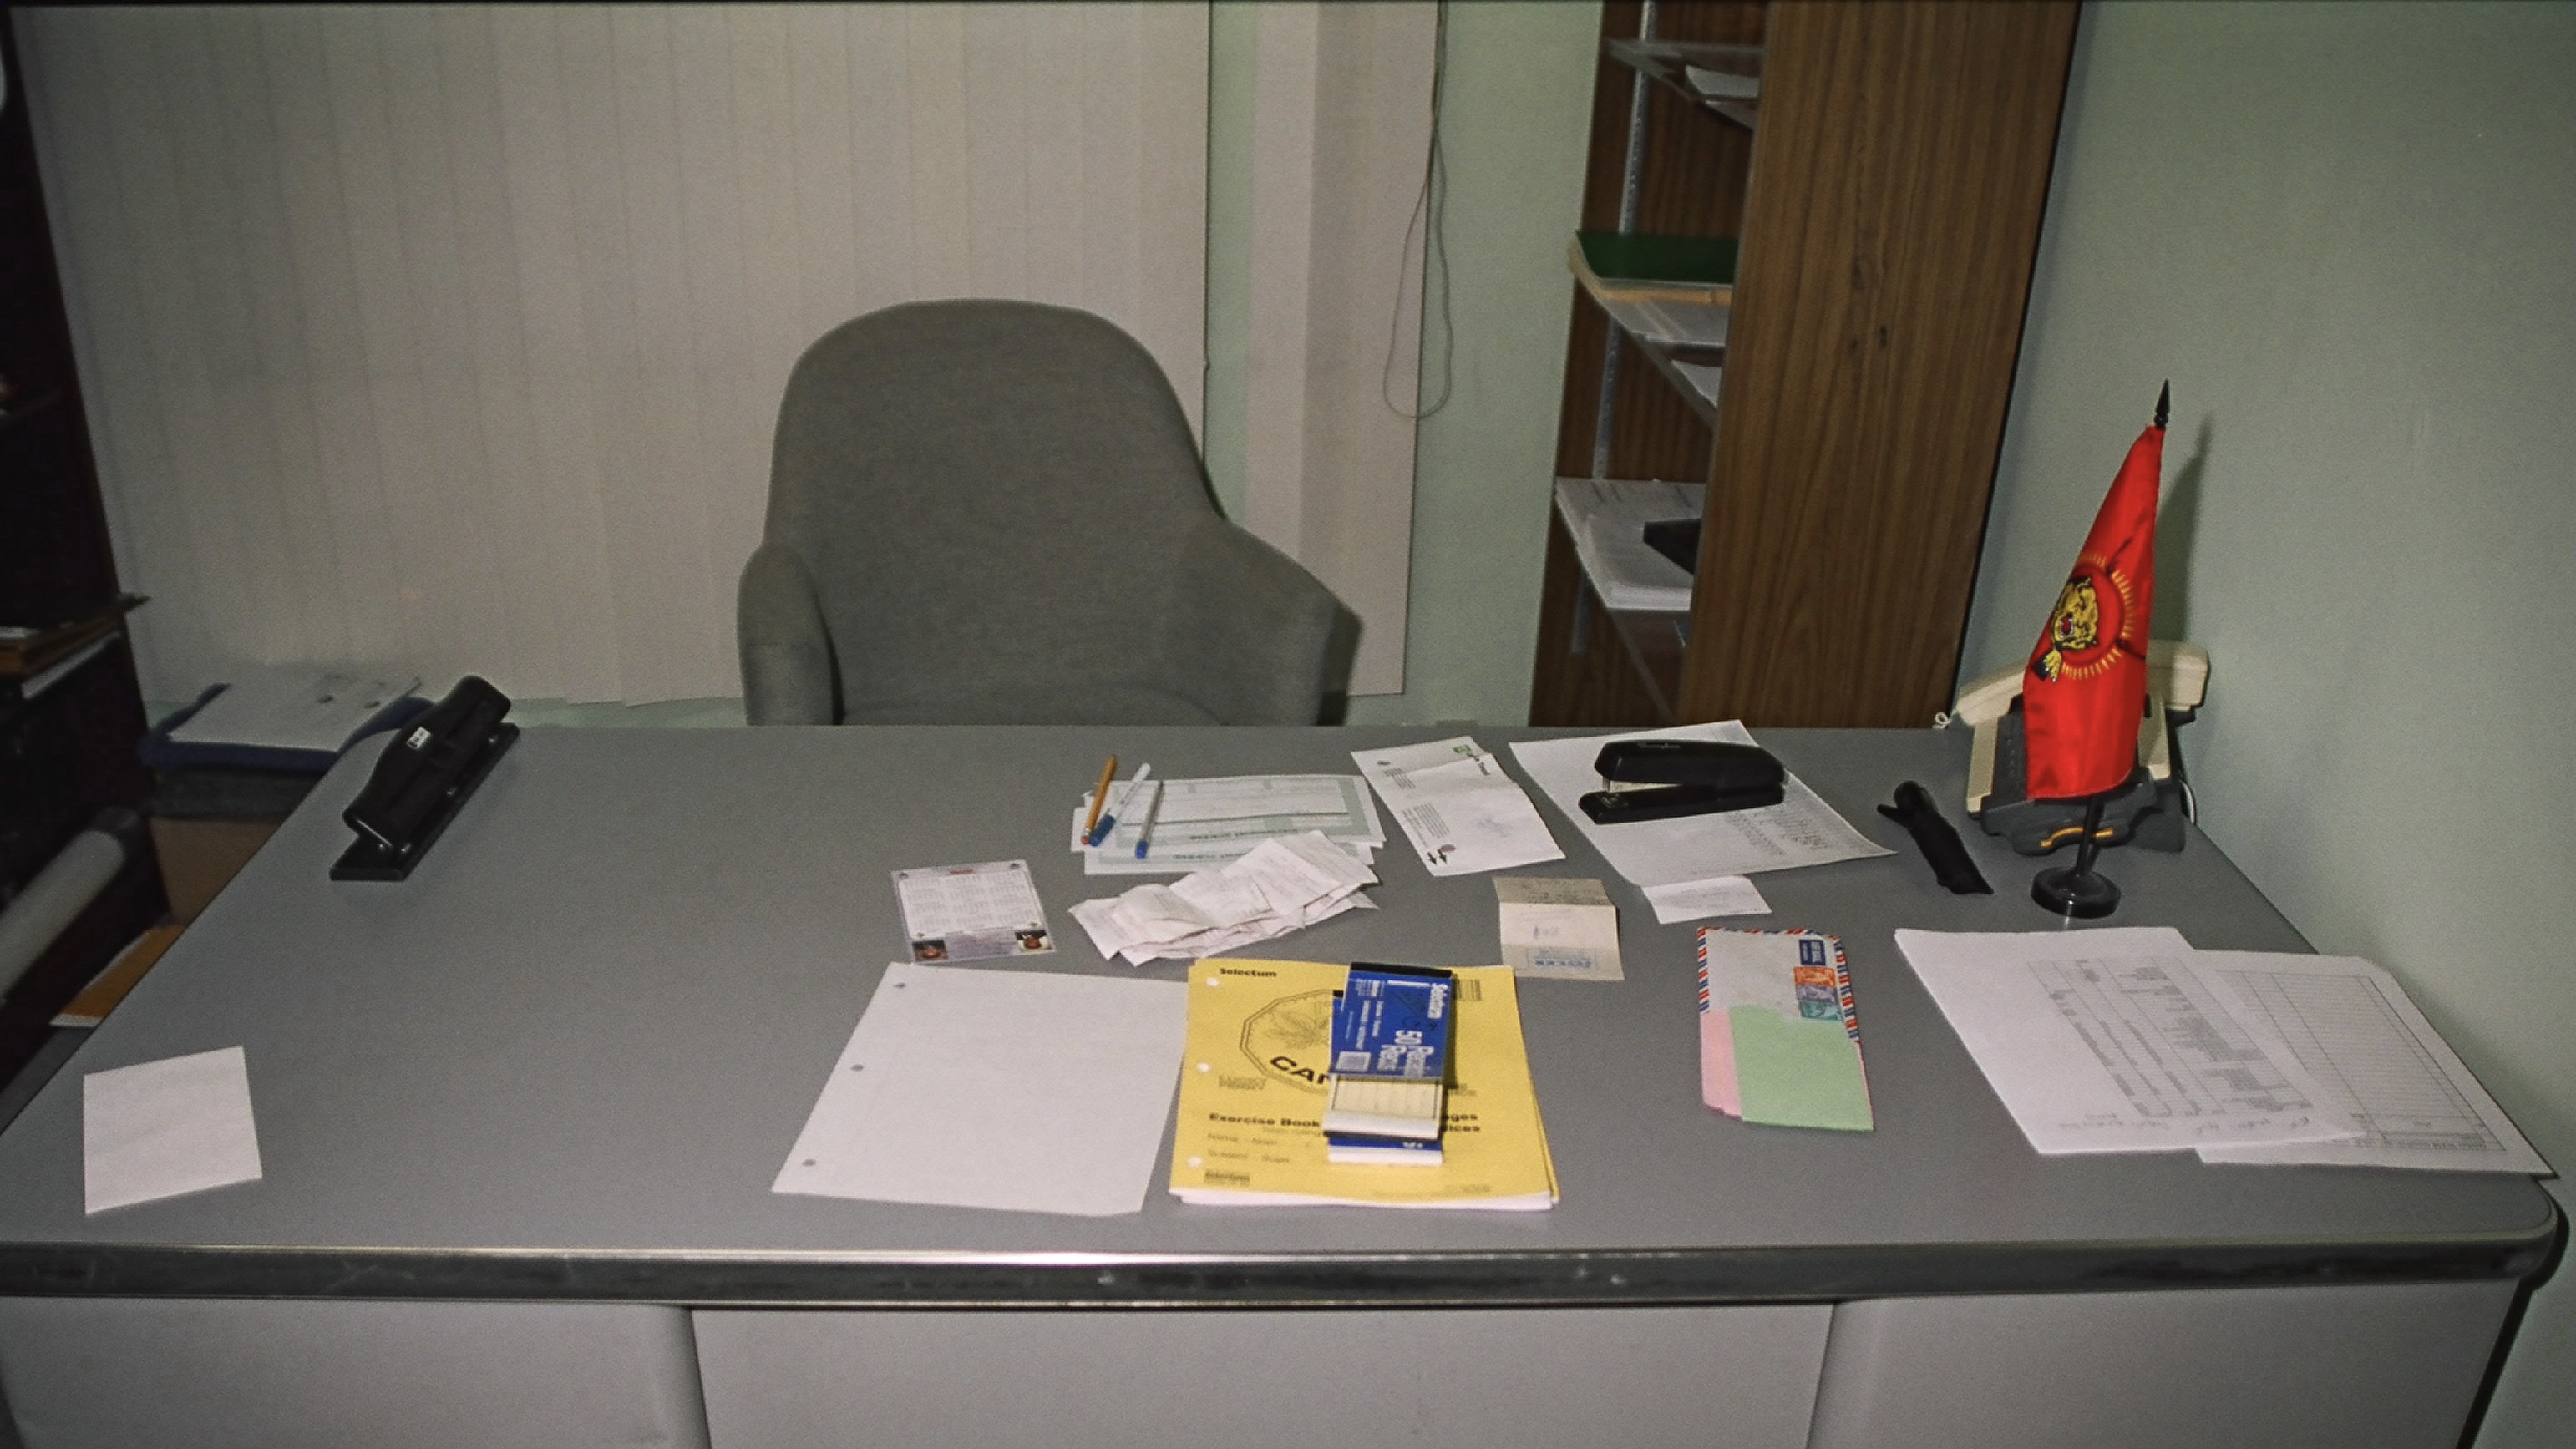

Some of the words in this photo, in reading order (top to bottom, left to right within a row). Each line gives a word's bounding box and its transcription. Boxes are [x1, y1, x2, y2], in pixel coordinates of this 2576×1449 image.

[1220, 968, 1277, 978] Selectum
[1209, 1113, 1276, 1126] Exercise
[1280, 1117, 1321, 1127] Book
